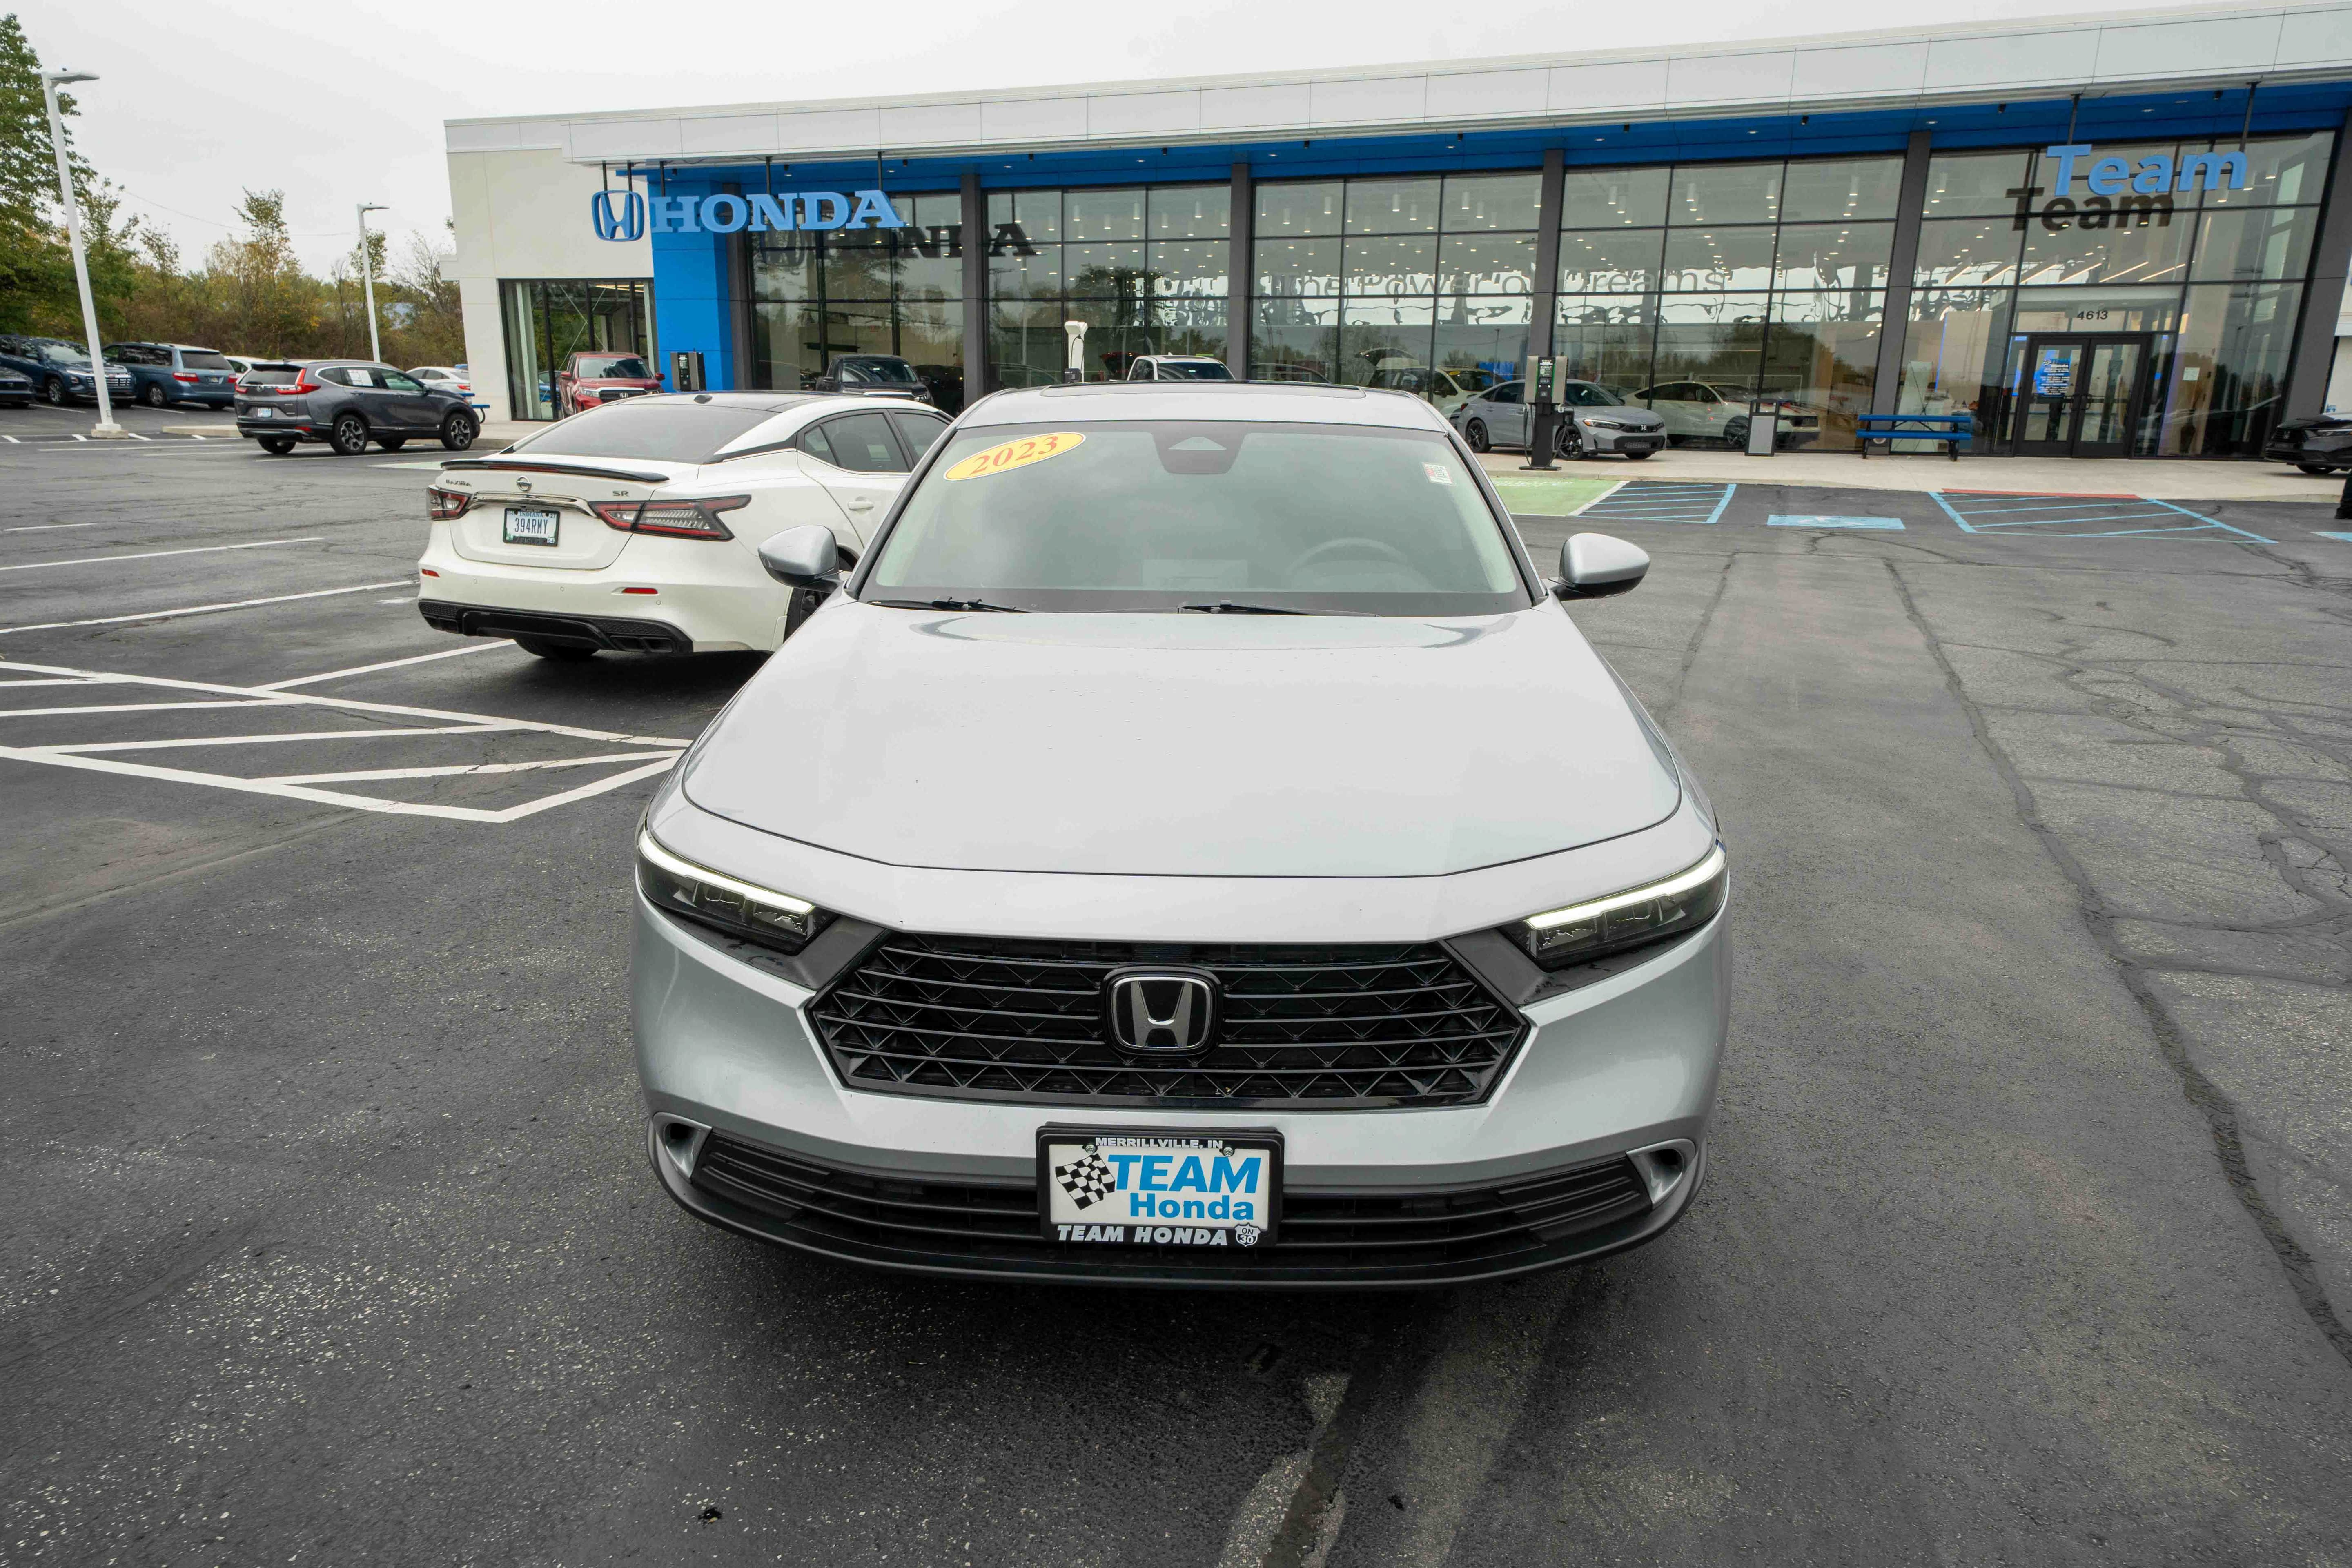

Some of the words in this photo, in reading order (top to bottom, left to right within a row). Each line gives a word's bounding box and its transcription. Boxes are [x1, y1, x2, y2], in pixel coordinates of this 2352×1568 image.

[2046, 144, 2248, 197] Team
[650, 189, 908, 233] HONDA
[2076, 310, 2107, 320] 4613
[969, 436, 1058, 476] 2023
[514, 518, 548, 534] 394RMY
[1095, 1137, 1203, 1149] MERRILLVILLE,
[1207, 1140, 1223, 1149] IN
[1107, 1154, 1261, 1193] TEAM
[1130, 1192, 1254, 1220] Honda
[1057, 1225, 1124, 1242] TEAM
[1134, 1227, 1227, 1245] HONDA
[1239, 1235, 1253, 1244] 30
